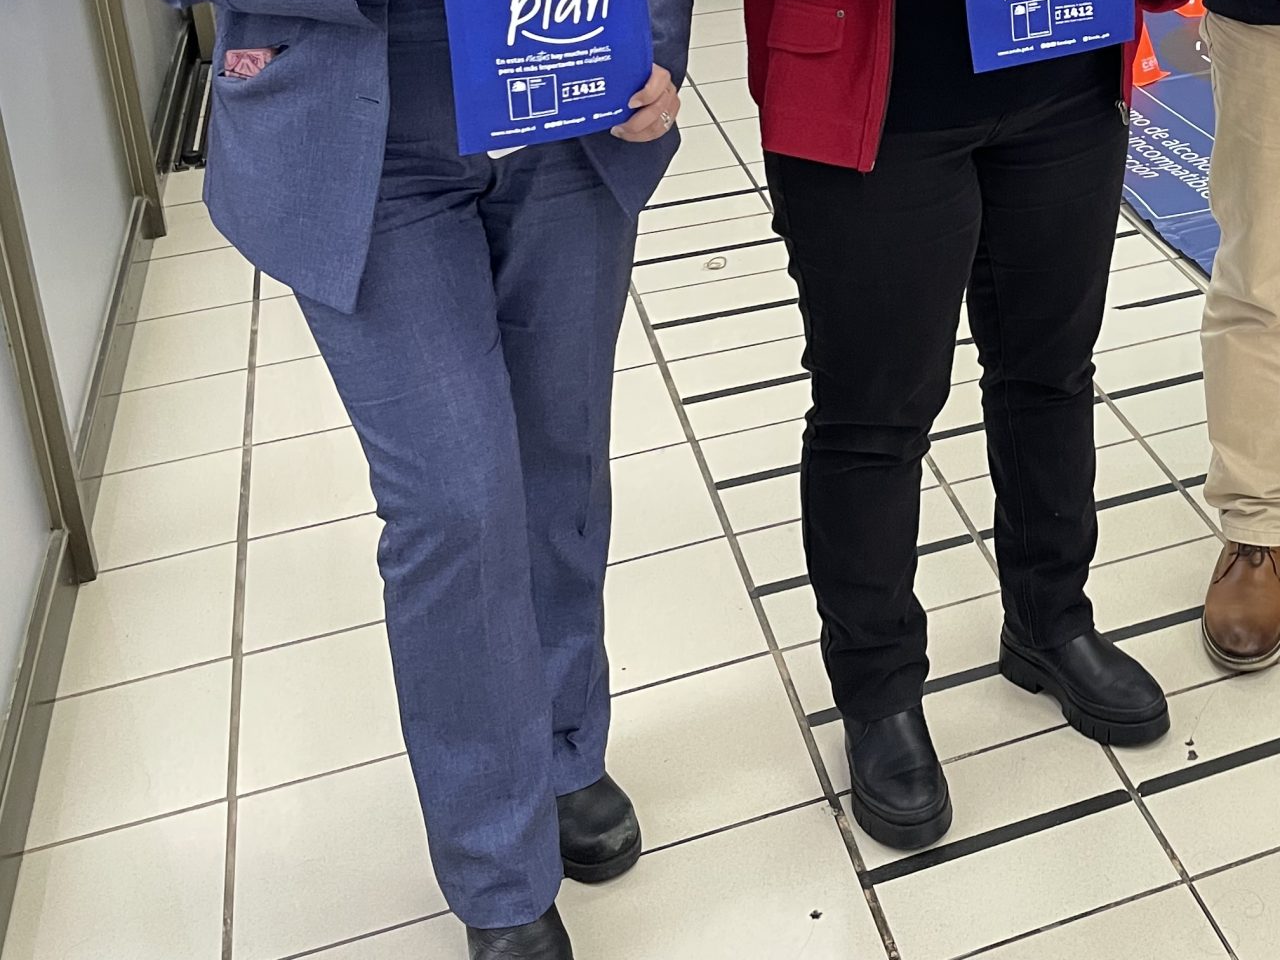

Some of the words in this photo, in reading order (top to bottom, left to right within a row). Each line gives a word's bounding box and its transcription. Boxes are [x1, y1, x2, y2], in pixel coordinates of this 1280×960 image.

[1063, 4, 1094, 20] 1412
[571, 80, 606, 96] 1412
[1143, 127, 1169, 140] de
